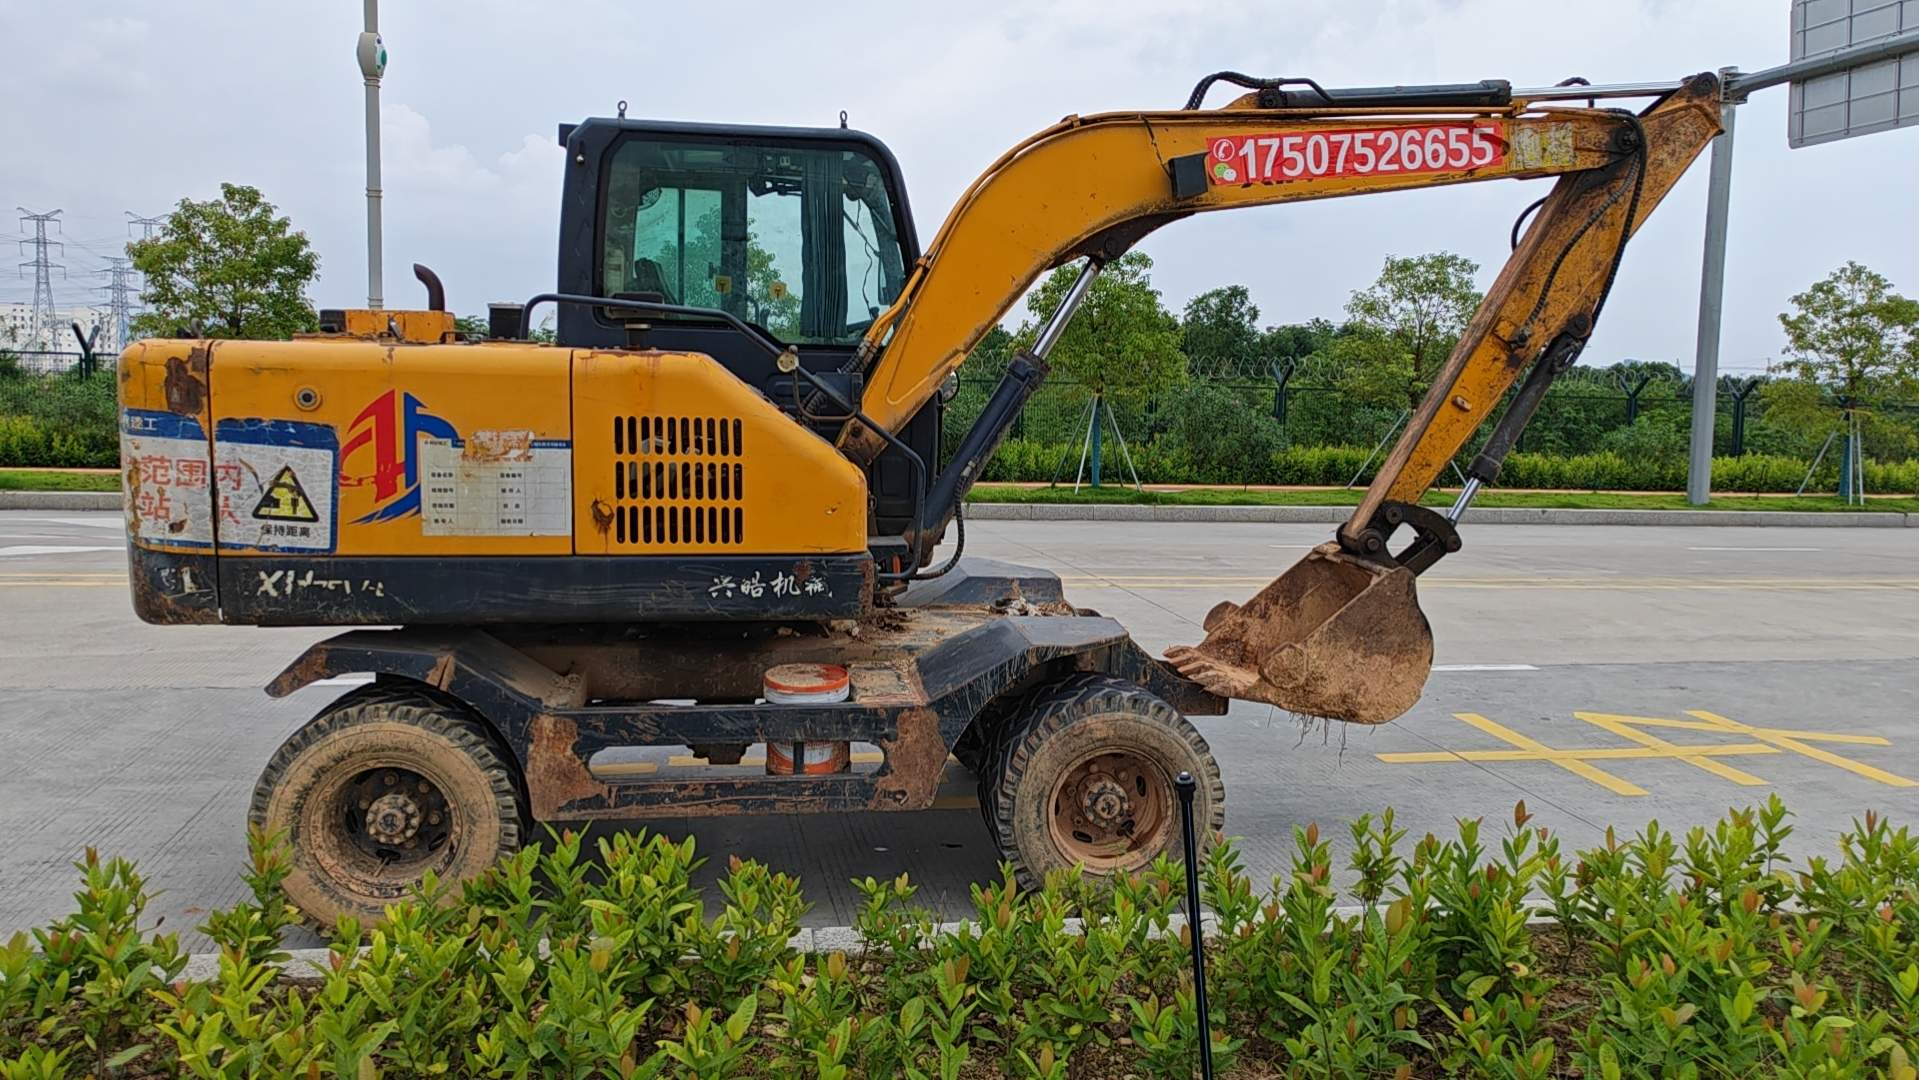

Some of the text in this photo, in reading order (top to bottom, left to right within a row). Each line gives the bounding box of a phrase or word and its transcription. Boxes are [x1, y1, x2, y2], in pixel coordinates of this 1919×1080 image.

[1239, 128, 1495, 179] 17507526655
[260, 523, 311, 538] 保持距离
